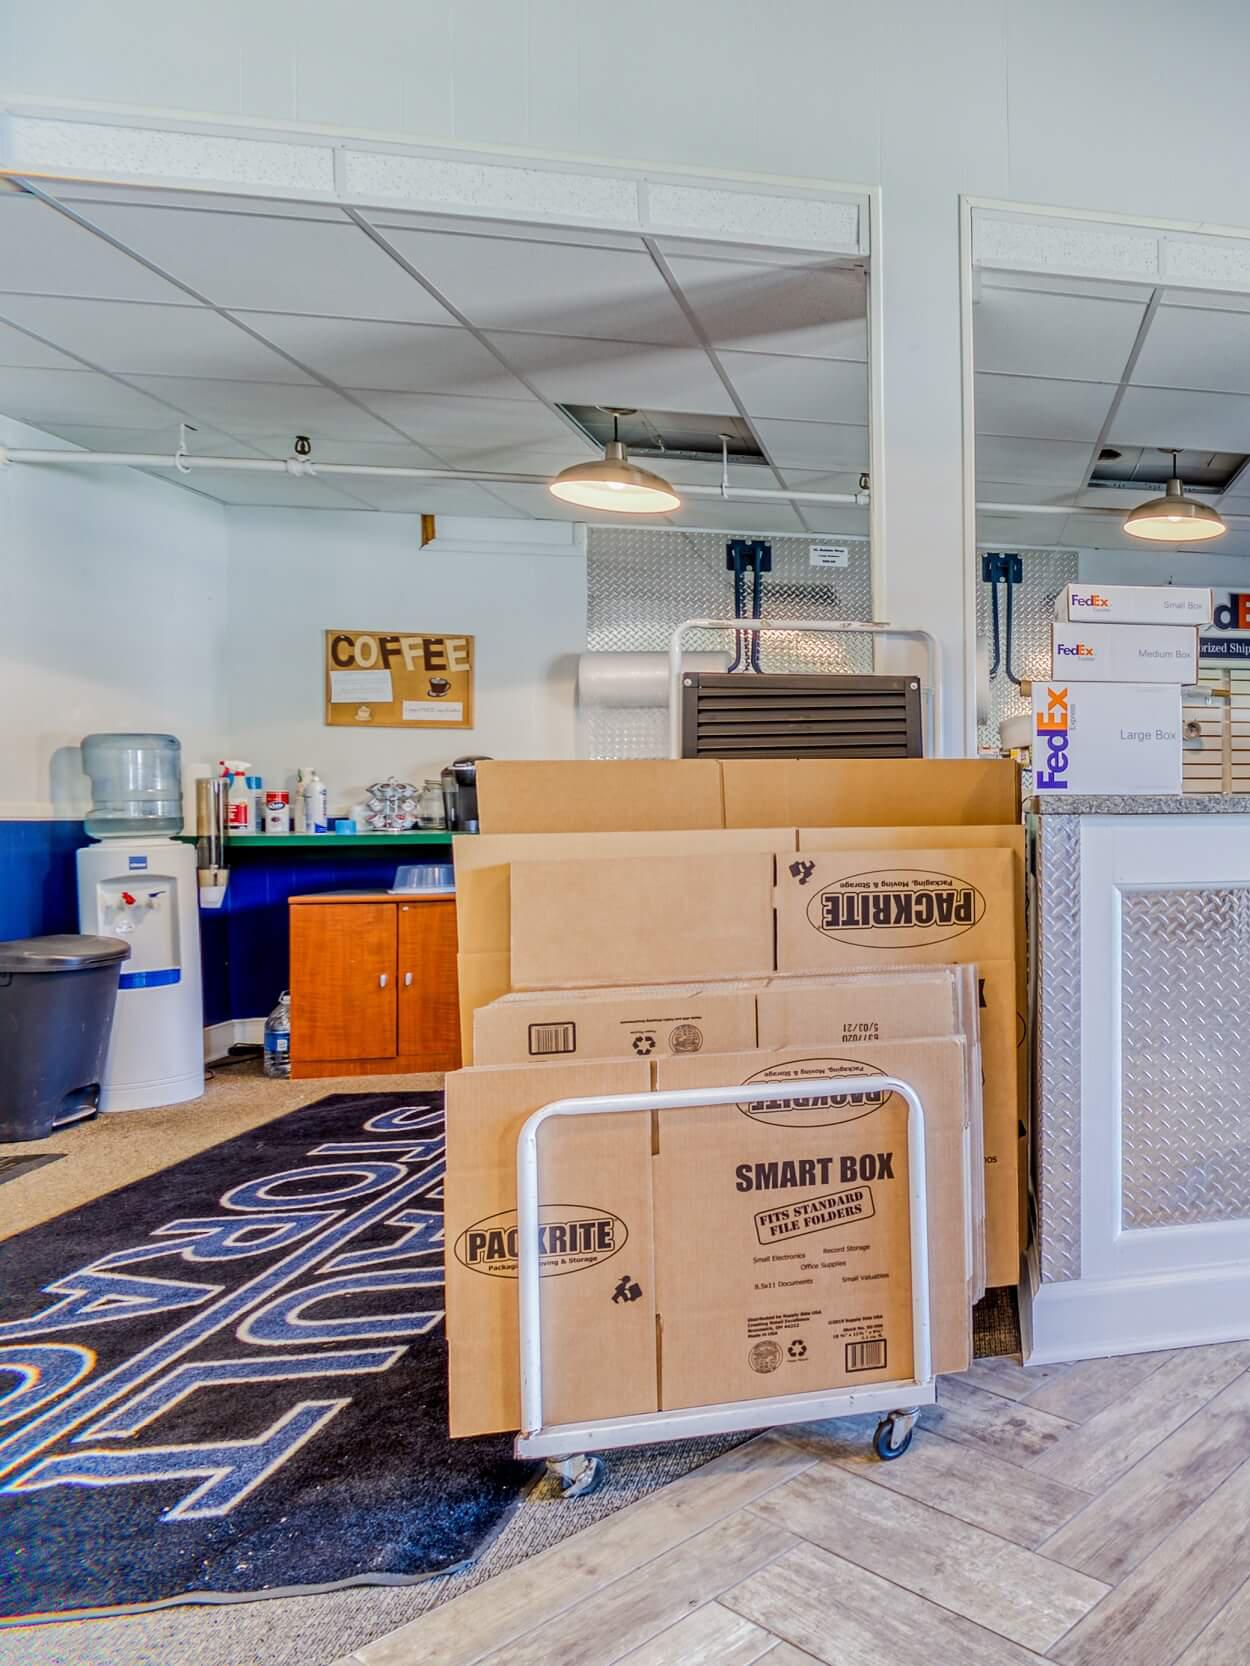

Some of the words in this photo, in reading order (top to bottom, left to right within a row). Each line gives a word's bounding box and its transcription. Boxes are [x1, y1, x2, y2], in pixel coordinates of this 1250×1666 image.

[1071, 594, 1109, 608] FedEx
[1163, 599, 1186, 609] Small
[1188, 600, 1202, 609] Box
[331, 634, 472, 672] COFFEE
[1057, 643, 1094, 656] FedEx
[1138, 649, 1174, 659] Medium
[1175, 650, 1191, 659] Box
[1200, 642, 1227, 653] orized
[1036, 687, 1069, 790] FedEx
[1120, 729, 1152, 743] Large
[1155, 729, 1176, 741] Box
[823, 890, 974, 928] PACKRITE
[735, 1157, 833, 1192] SMART
[840, 1152, 895, 1183] BOX
[759, 1209, 790, 1226] FITS
[793, 1191, 863, 1217] STANDARD
[770, 1221, 801, 1236] FILE
[804, 1204, 863, 1228] FOLDERS
[568, 1255, 598, 1264] Storage
[771, 1253, 806, 1262] Electronics
